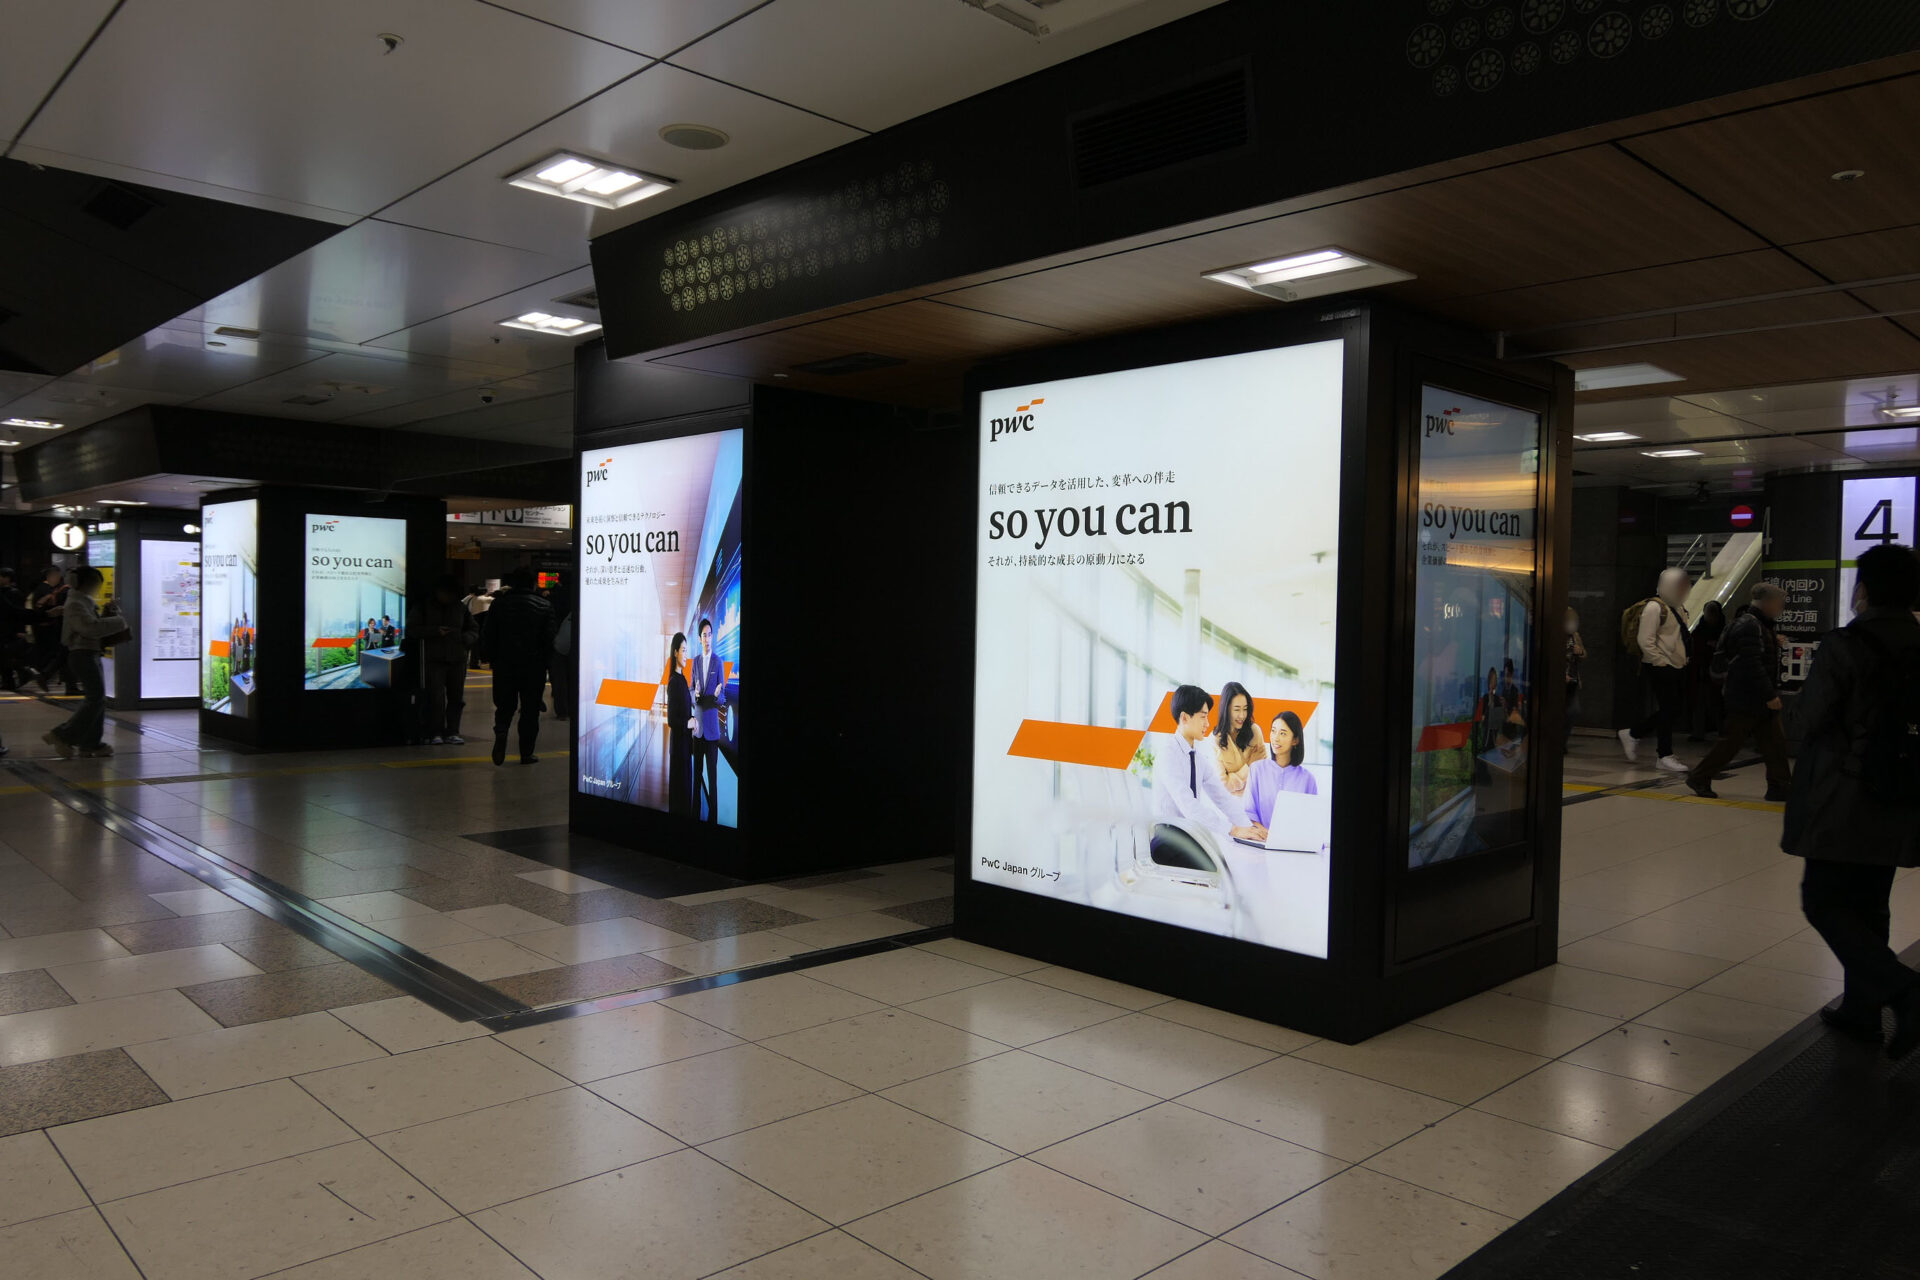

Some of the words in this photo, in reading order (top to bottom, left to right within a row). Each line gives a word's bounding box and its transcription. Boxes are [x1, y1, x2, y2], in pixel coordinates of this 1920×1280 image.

[990, 414, 1034, 442] pwc
[1425, 414, 1454, 438] pwc
[586, 468, 608, 487] pwc
[989, 470, 1176, 496] 信頼できるデータを活用した、変革への伴走
[312, 524, 335, 533] pwc
[989, 509, 1028, 540] so
[1034, 503, 1107, 550] you
[1115, 498, 1193, 535] can
[1423, 502, 1447, 528] so
[1449, 506, 1486, 539] you
[1489, 511, 1521, 537] can
[1855, 499, 1899, 544] 4
[586, 535, 605, 555] so
[608, 531, 641, 562] you
[645, 529, 680, 553] can
[311, 555, 330, 567] so
[332, 556, 362, 570] you
[365, 557, 394, 569] can
[988, 553, 1146, 568] それが、持続的な成長の原動力になる
[1792, 594, 1813, 603] Line
[582, 774, 593, 783] PwC
[981, 857, 1000, 869] PwC
[1002, 861, 1028, 876] Japan
[1030, 866, 1061, 882] グループ
